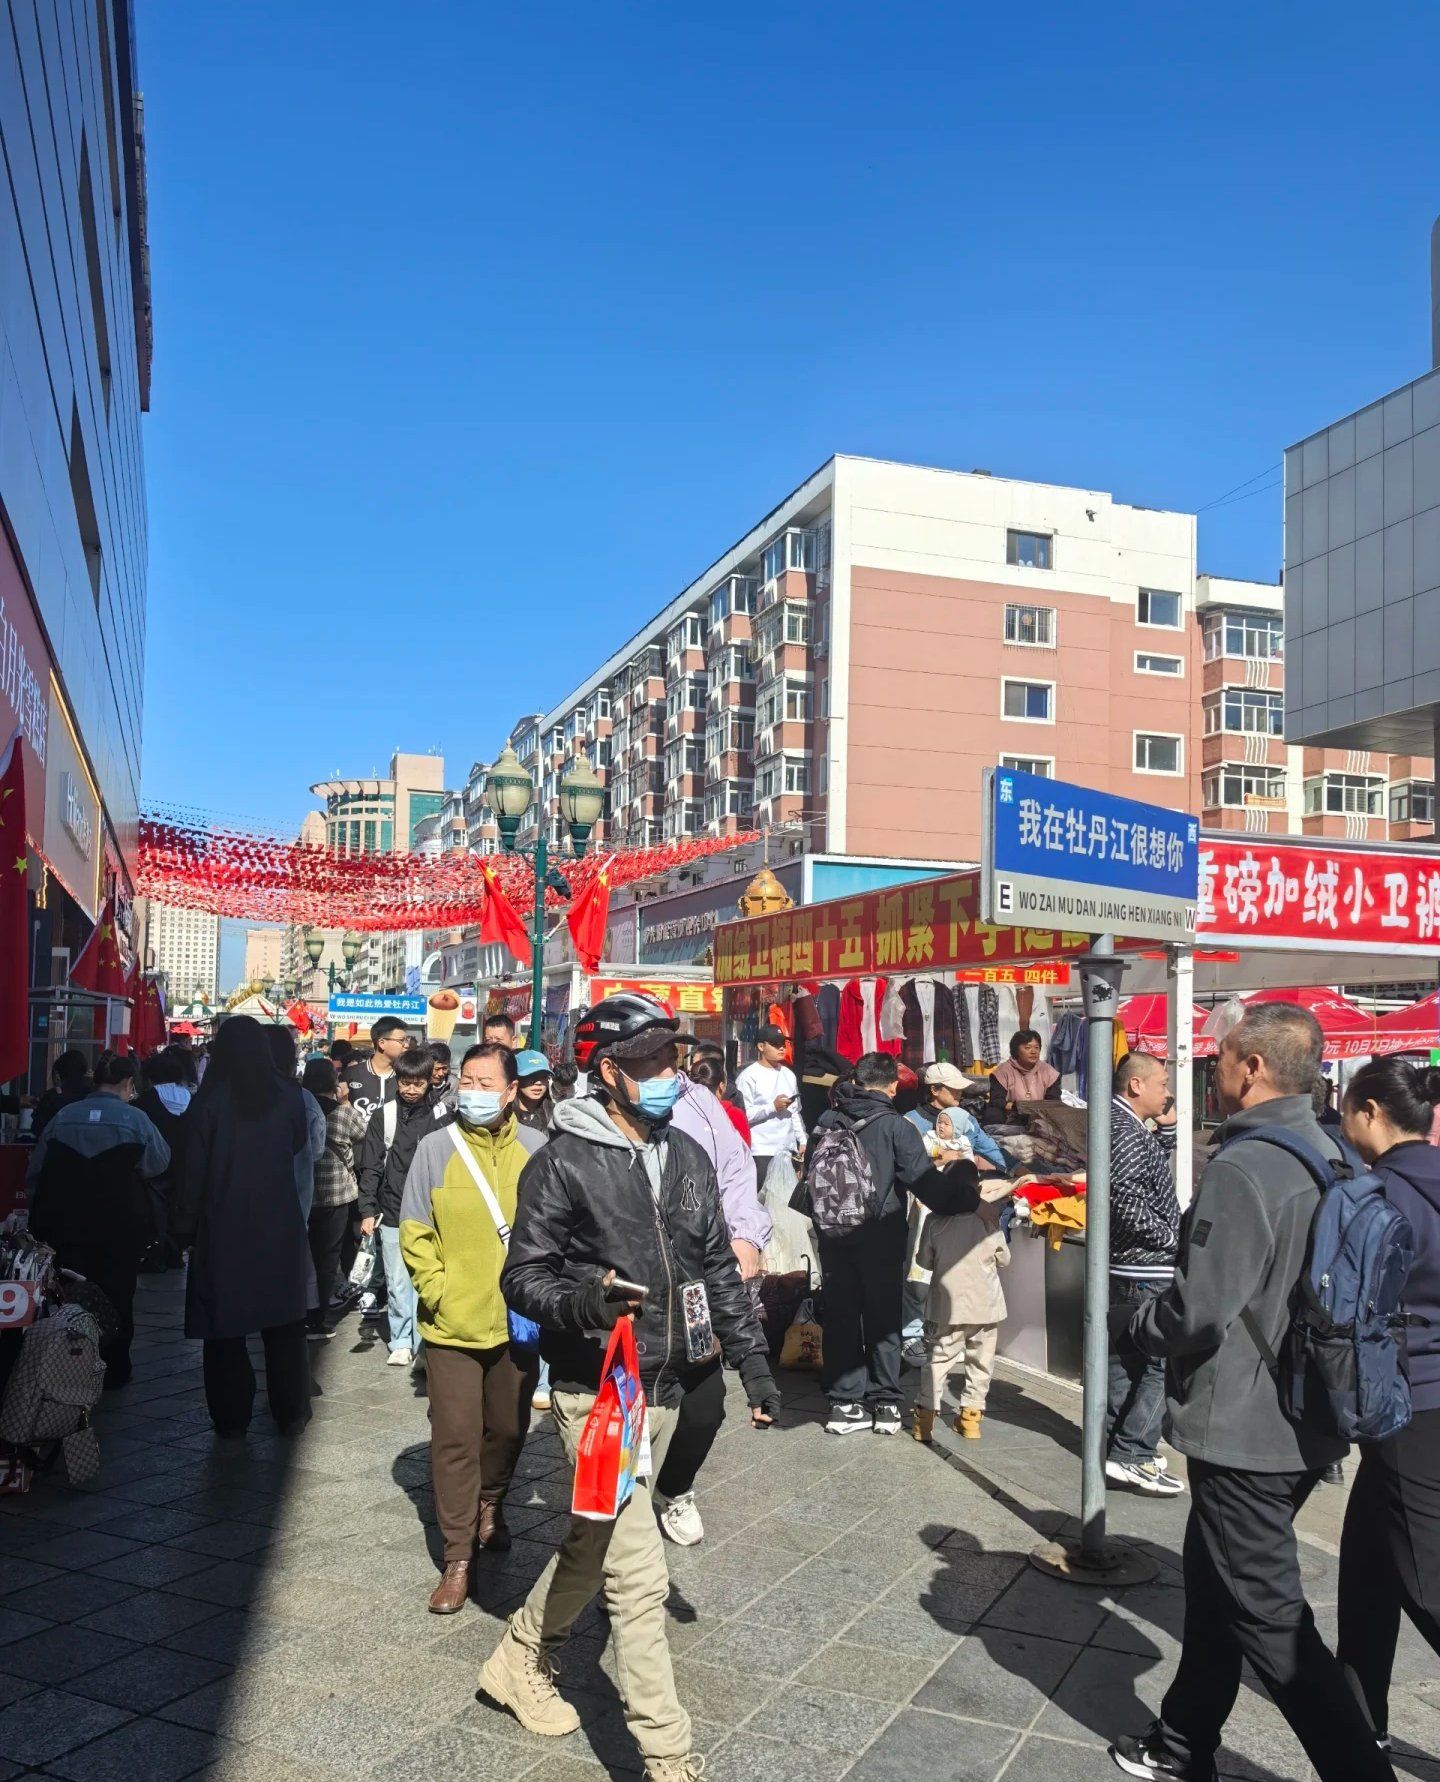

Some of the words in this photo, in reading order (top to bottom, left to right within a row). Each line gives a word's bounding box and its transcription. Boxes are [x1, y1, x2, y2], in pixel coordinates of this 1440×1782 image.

[999, 778, 1013, 802] 东
[1018, 798, 1184, 874] 我在牡丹江很想你
[1187, 822, 1198, 844] 西
[1000, 884, 1011, 910] E
[1198, 850, 1440, 939] 重磅加绒小卫裤
[1019, 890, 1038, 910] WO
[1039, 893, 1056, 913] ZAI
[1058, 897, 1074, 915] MU
[1076, 898, 1096, 917] DAN
[1098, 901, 1127, 921] JIANG
[1129, 905, 1146, 923] HEN
[1147, 907, 1172, 926] XIANG
[1173, 912, 1182, 927] NI
[1185, 909, 1196, 930] W
[964, 967, 1017, 984] 一百五
[1023, 968, 1059, 984] 四件
[336, 997, 420, 1010] 我是如此热爱牡丹江
